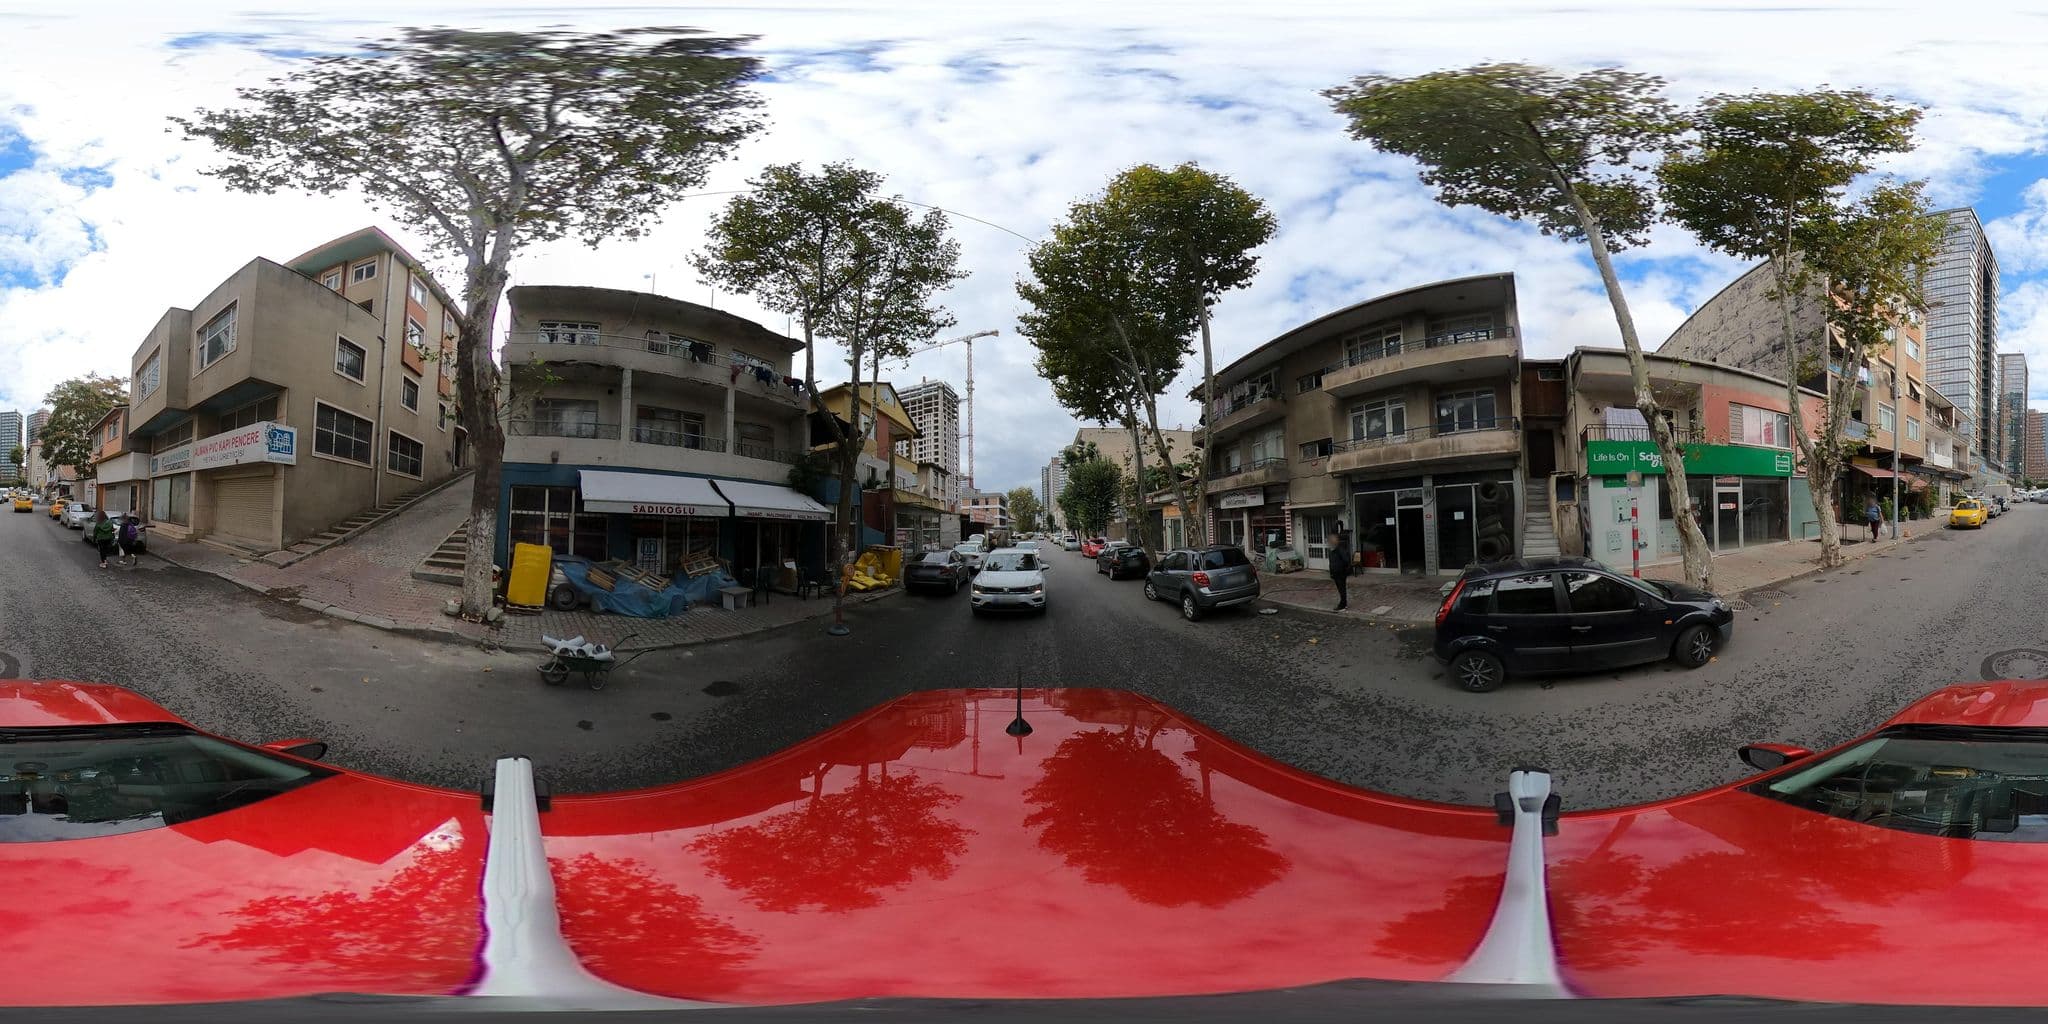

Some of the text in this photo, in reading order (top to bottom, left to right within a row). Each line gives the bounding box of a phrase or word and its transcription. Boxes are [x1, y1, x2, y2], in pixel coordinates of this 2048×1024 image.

[231, 430, 260, 448] PENCERE
[1593, 452, 1629, 462] Life Is On
